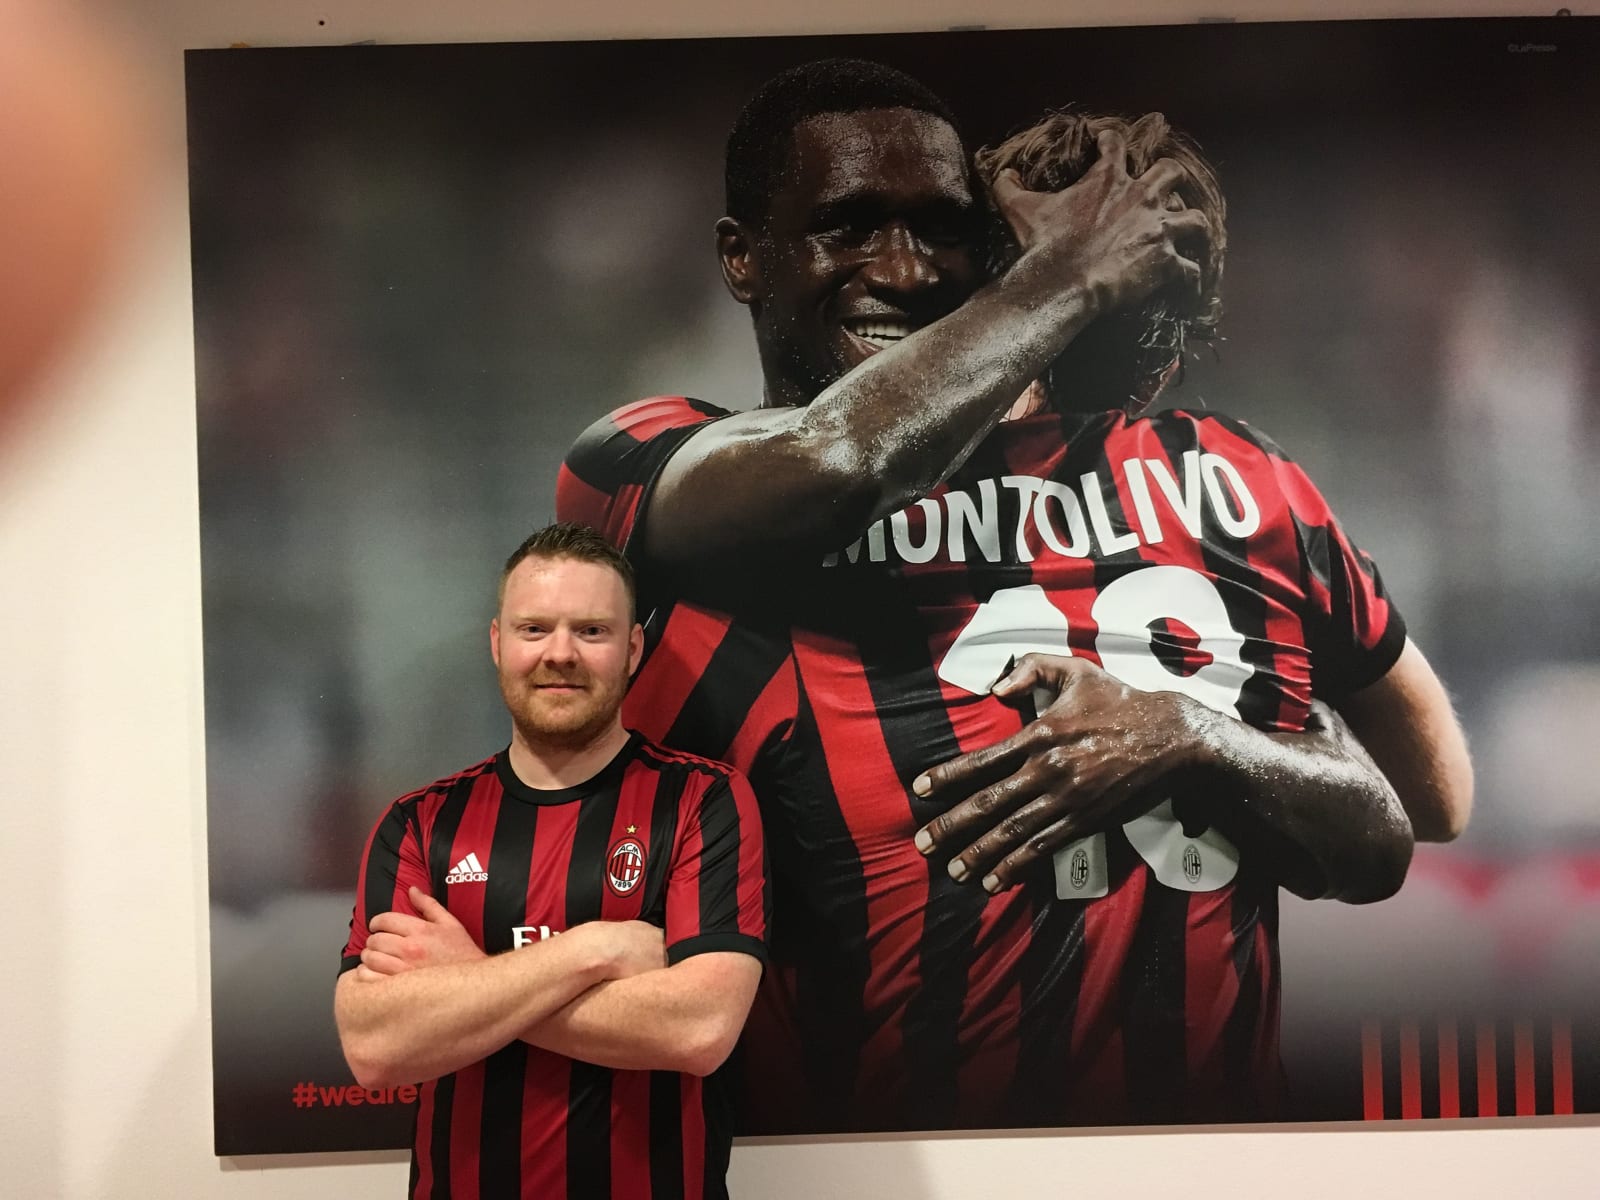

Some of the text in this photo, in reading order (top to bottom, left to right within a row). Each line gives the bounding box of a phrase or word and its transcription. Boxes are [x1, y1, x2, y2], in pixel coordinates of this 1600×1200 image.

[618, 845, 639, 855] ACM
[445, 871, 488, 885] adidas
[614, 881, 632, 889] 1899
[511, 925, 562, 951] Fl
